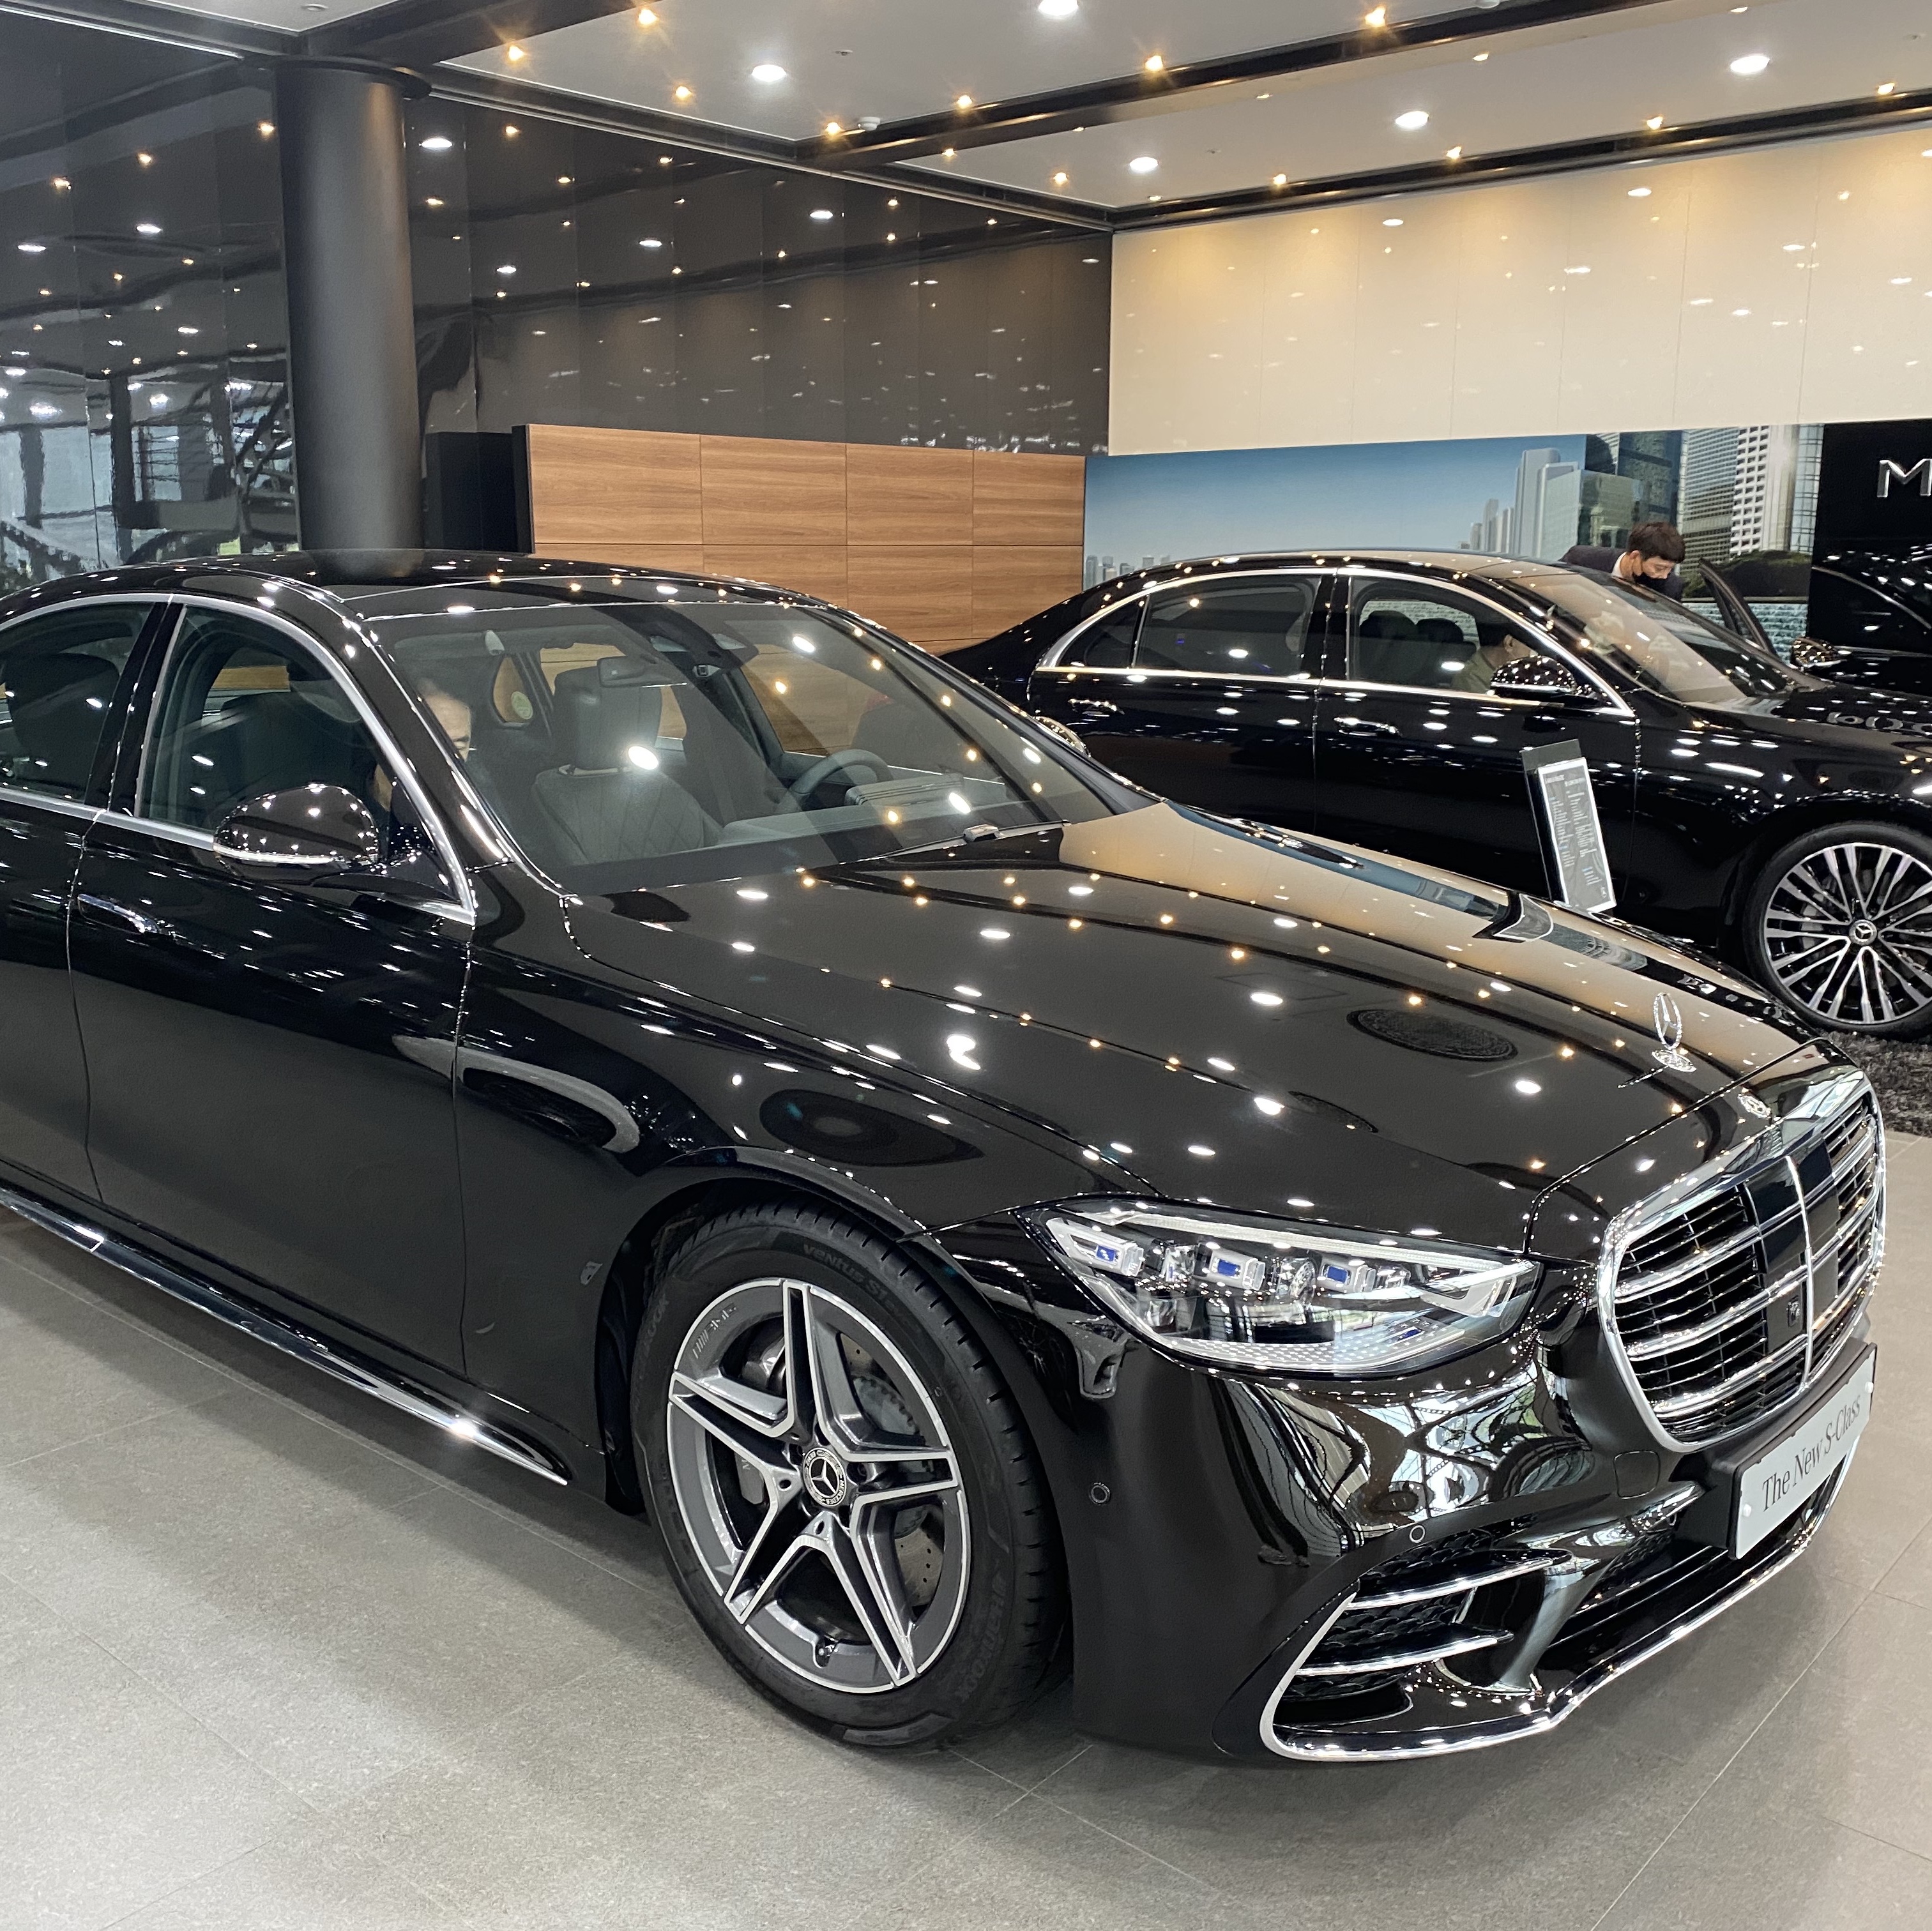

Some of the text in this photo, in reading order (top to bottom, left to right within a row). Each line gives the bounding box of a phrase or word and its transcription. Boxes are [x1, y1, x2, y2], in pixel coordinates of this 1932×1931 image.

[1876, 458, 1932, 498] M
[1762, 1395, 1860, 1512] The New S-Class
